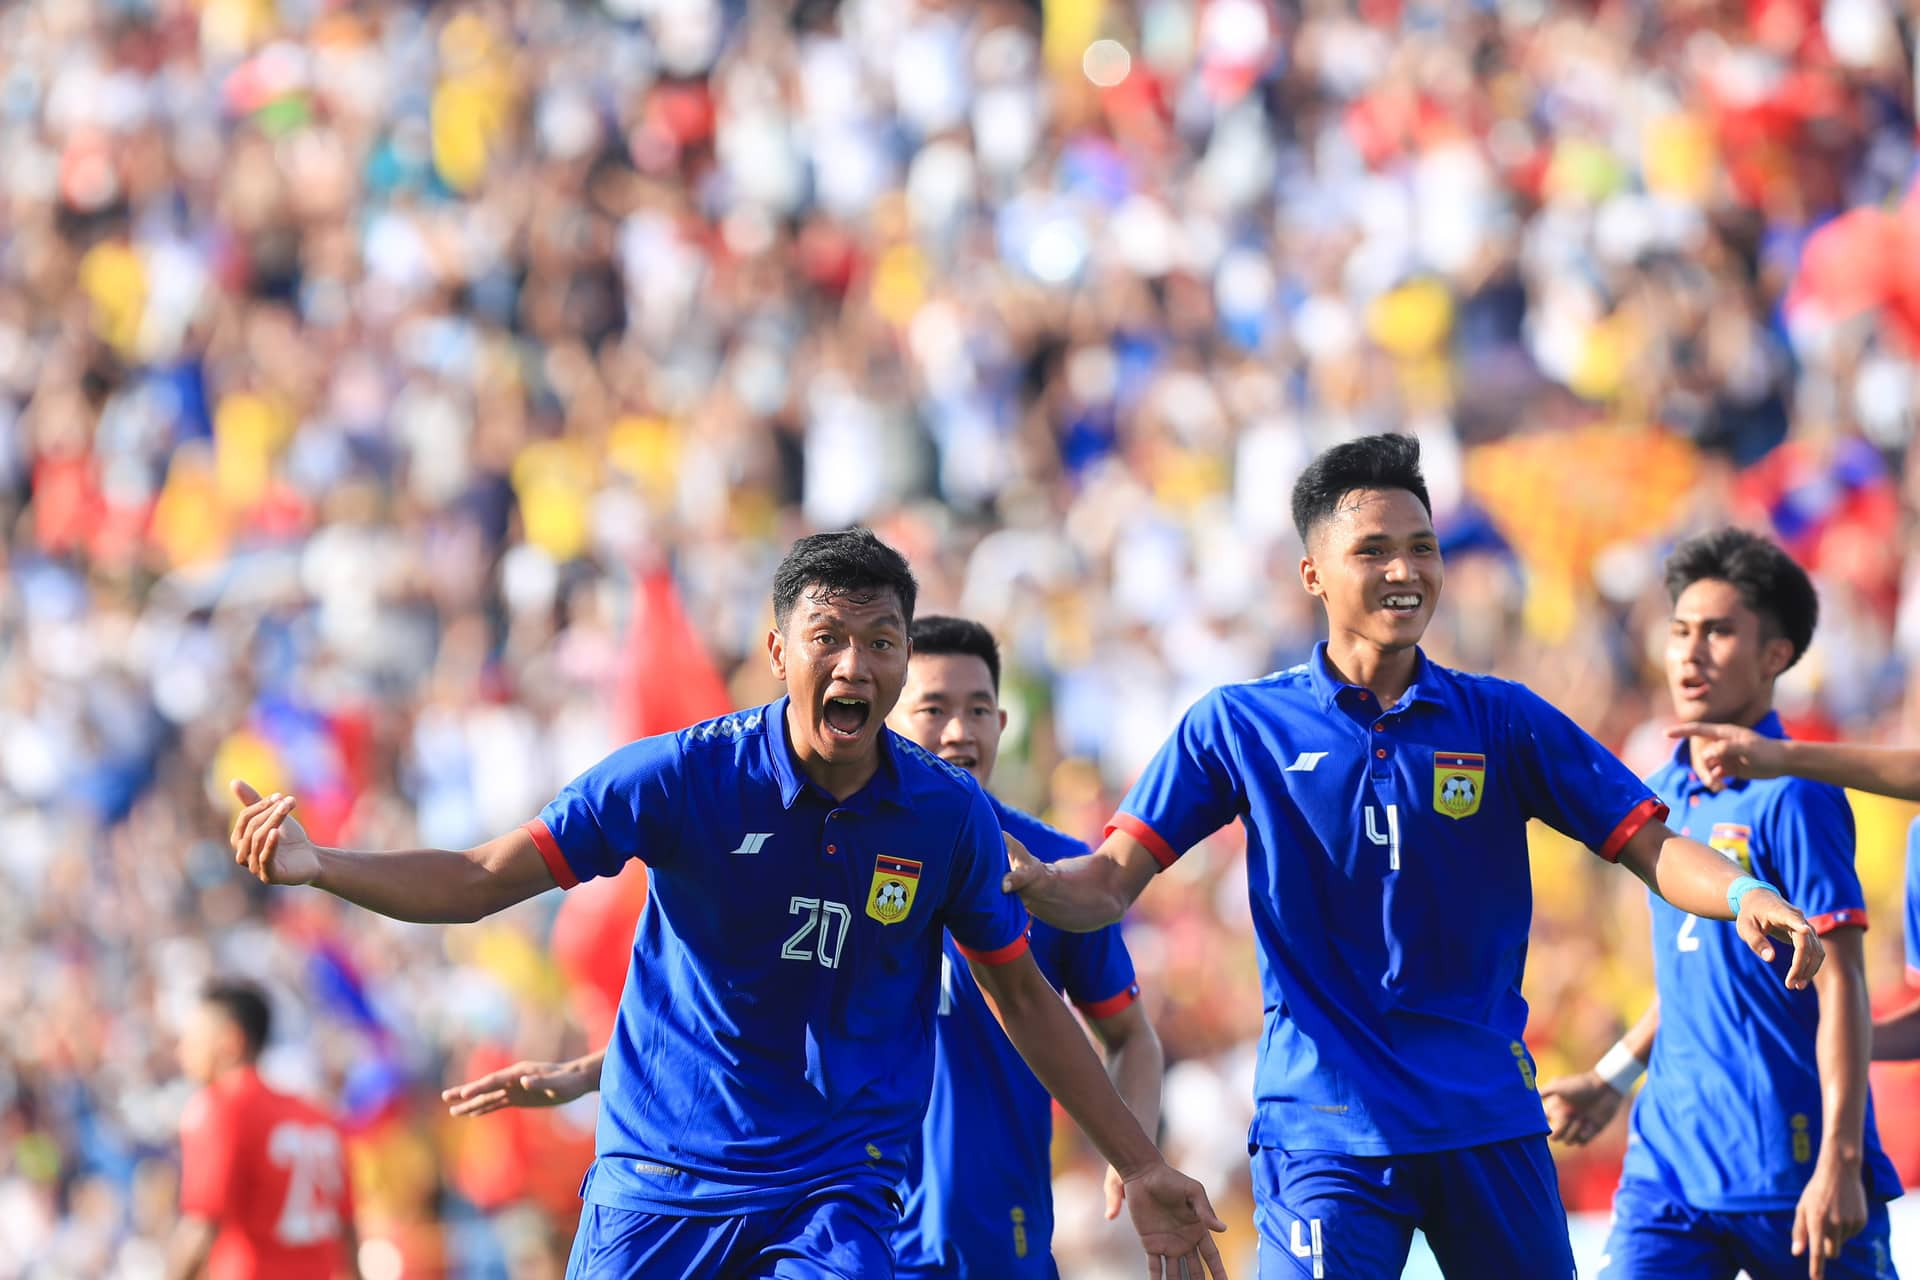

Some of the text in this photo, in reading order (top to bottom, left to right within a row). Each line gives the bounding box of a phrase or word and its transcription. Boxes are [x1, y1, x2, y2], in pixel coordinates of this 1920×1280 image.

[1364, 804, 1401, 871] 4
[780, 896, 852, 969] 20
[1290, 1218, 1324, 1279] 4
